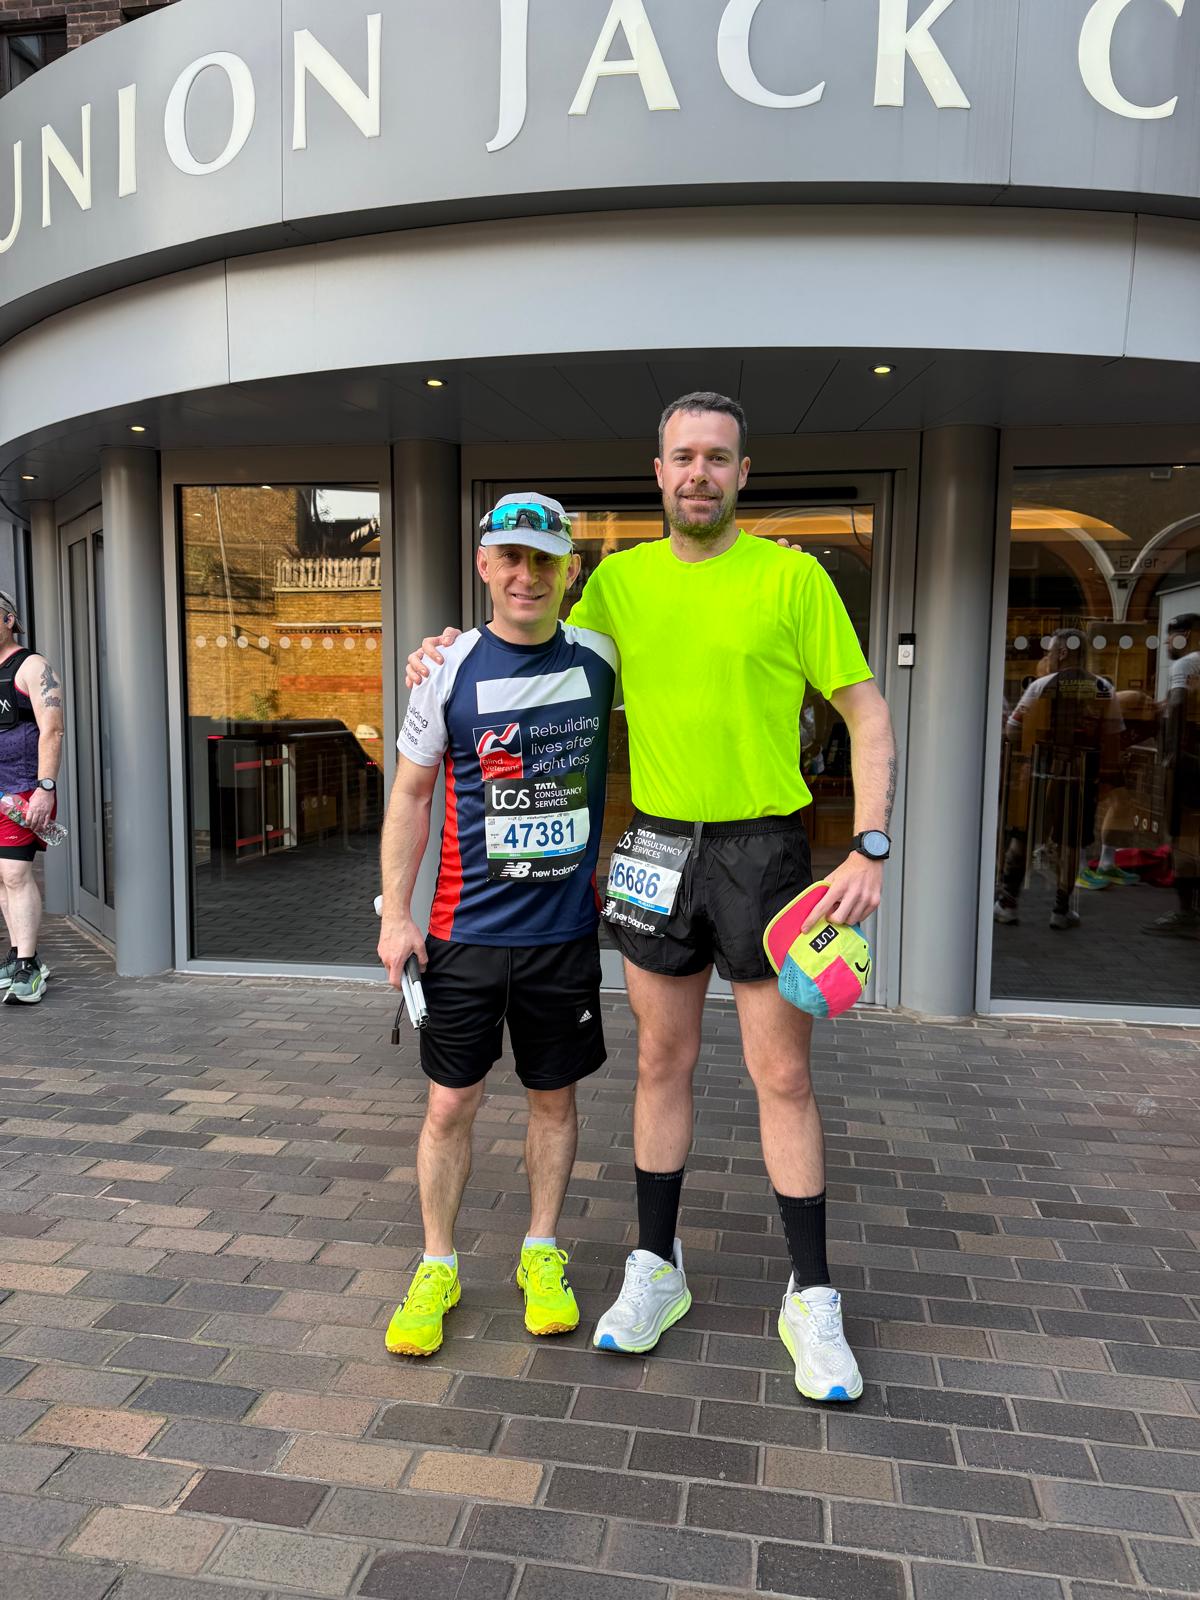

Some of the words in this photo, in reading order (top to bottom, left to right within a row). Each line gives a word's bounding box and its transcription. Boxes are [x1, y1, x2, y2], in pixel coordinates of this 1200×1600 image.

[485, 0, 972, 153] JACK
[529, 716, 599, 739] Rebuilding
[531, 742, 562, 756] lives
[566, 735, 596, 750] after
[532, 757, 566, 774] sight
[568, 753, 590, 766] loss
[491, 784, 531, 810] tcs
[534, 782, 557, 791] TATA
[534, 786, 582, 799] CONSULTANCY
[534, 797, 568, 809] SERVICES
[503, 817, 575, 849] 47381
[637, 828, 656, 840] TATA
[631, 845, 661, 859] SERVICES
[634, 836, 682, 857] CONSULTANCY
[532, 870, 550, 878] new
